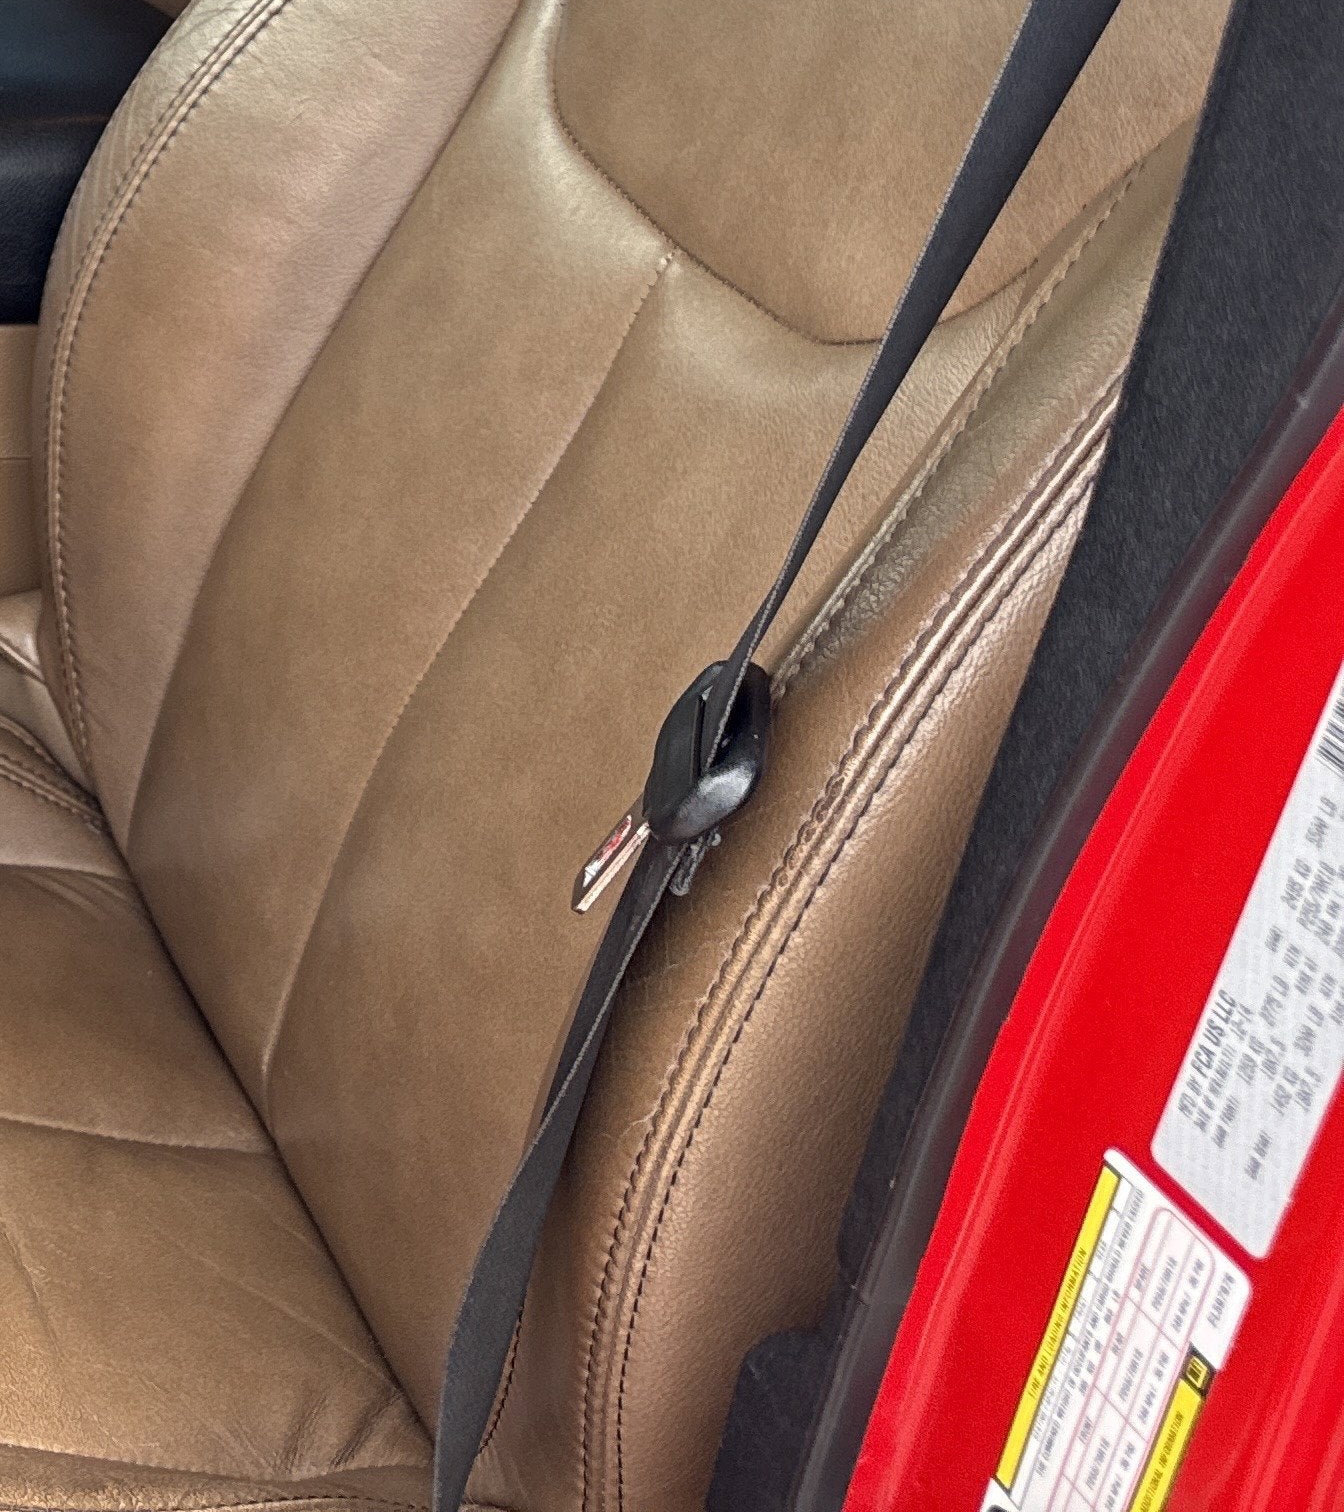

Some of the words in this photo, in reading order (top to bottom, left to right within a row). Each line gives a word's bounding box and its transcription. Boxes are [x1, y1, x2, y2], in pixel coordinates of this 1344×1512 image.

[1210, 987, 1238, 1025] LLC
[1201, 1017, 1226, 1048] US
[1188, 1041, 1217, 1079] FCA
[1036, 1354, 1049, 1378] AND
[1058, 1246, 1087, 1314] INFORMATION
